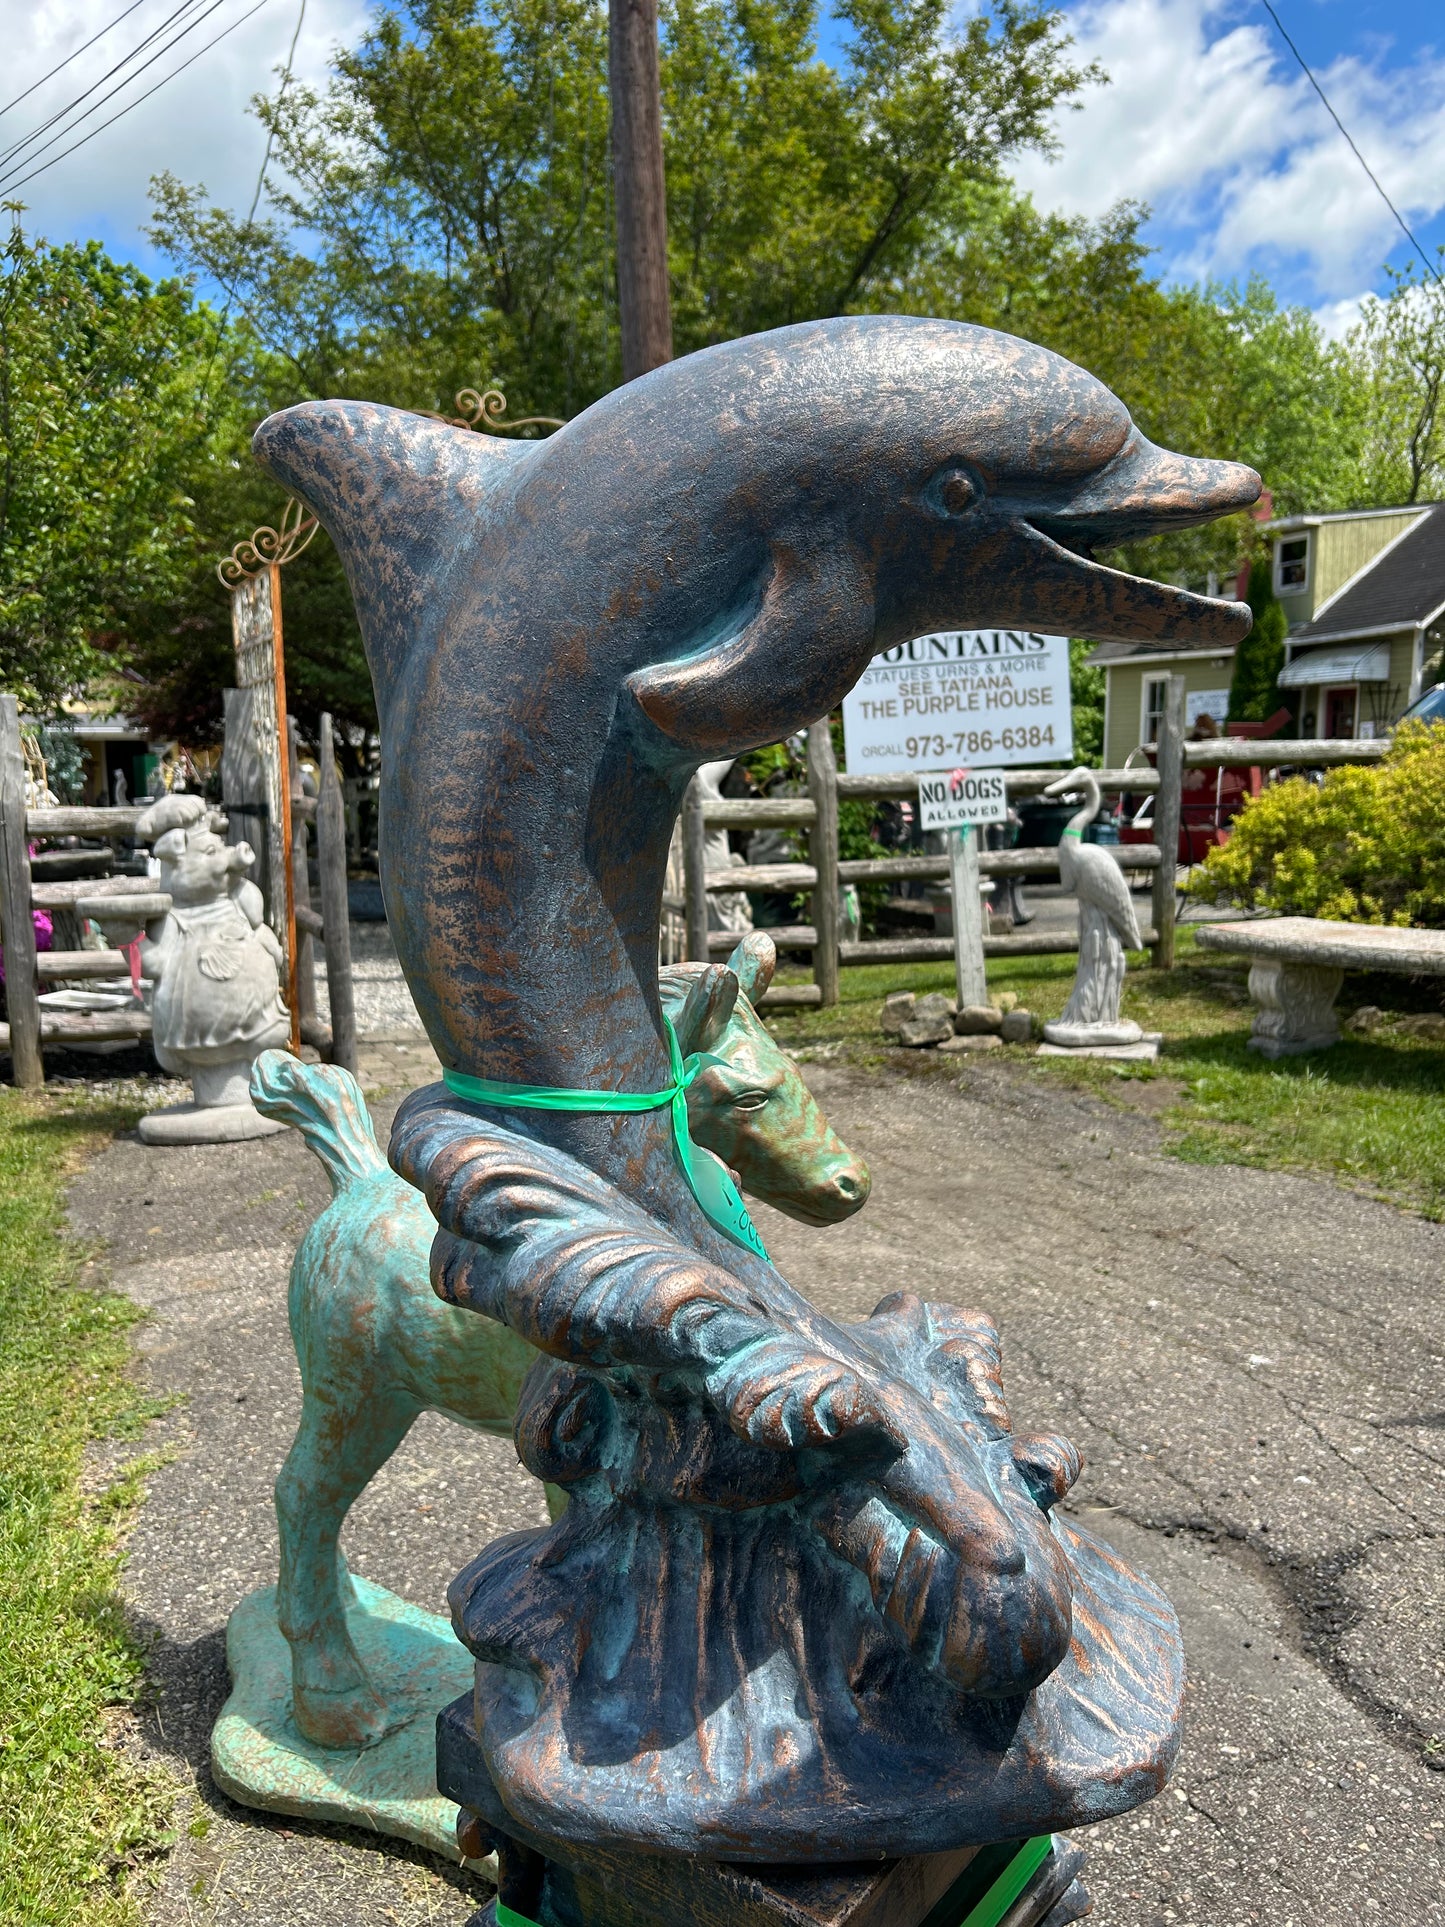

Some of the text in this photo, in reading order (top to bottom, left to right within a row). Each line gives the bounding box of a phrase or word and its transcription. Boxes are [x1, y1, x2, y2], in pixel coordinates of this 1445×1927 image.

[871, 632, 1045, 664] OUNTAINS
[863, 657, 1046, 685] STATUES URNS & MORE
[898, 674, 1013, 697] SEE TATIANA
[859, 687, 1053, 719] THE PURPLE HOUSE
[905, 724, 1055, 758] 973-786-6384
[921, 777, 1003, 804] NO DOGS
[928, 805, 998, 822] ALLOWED
